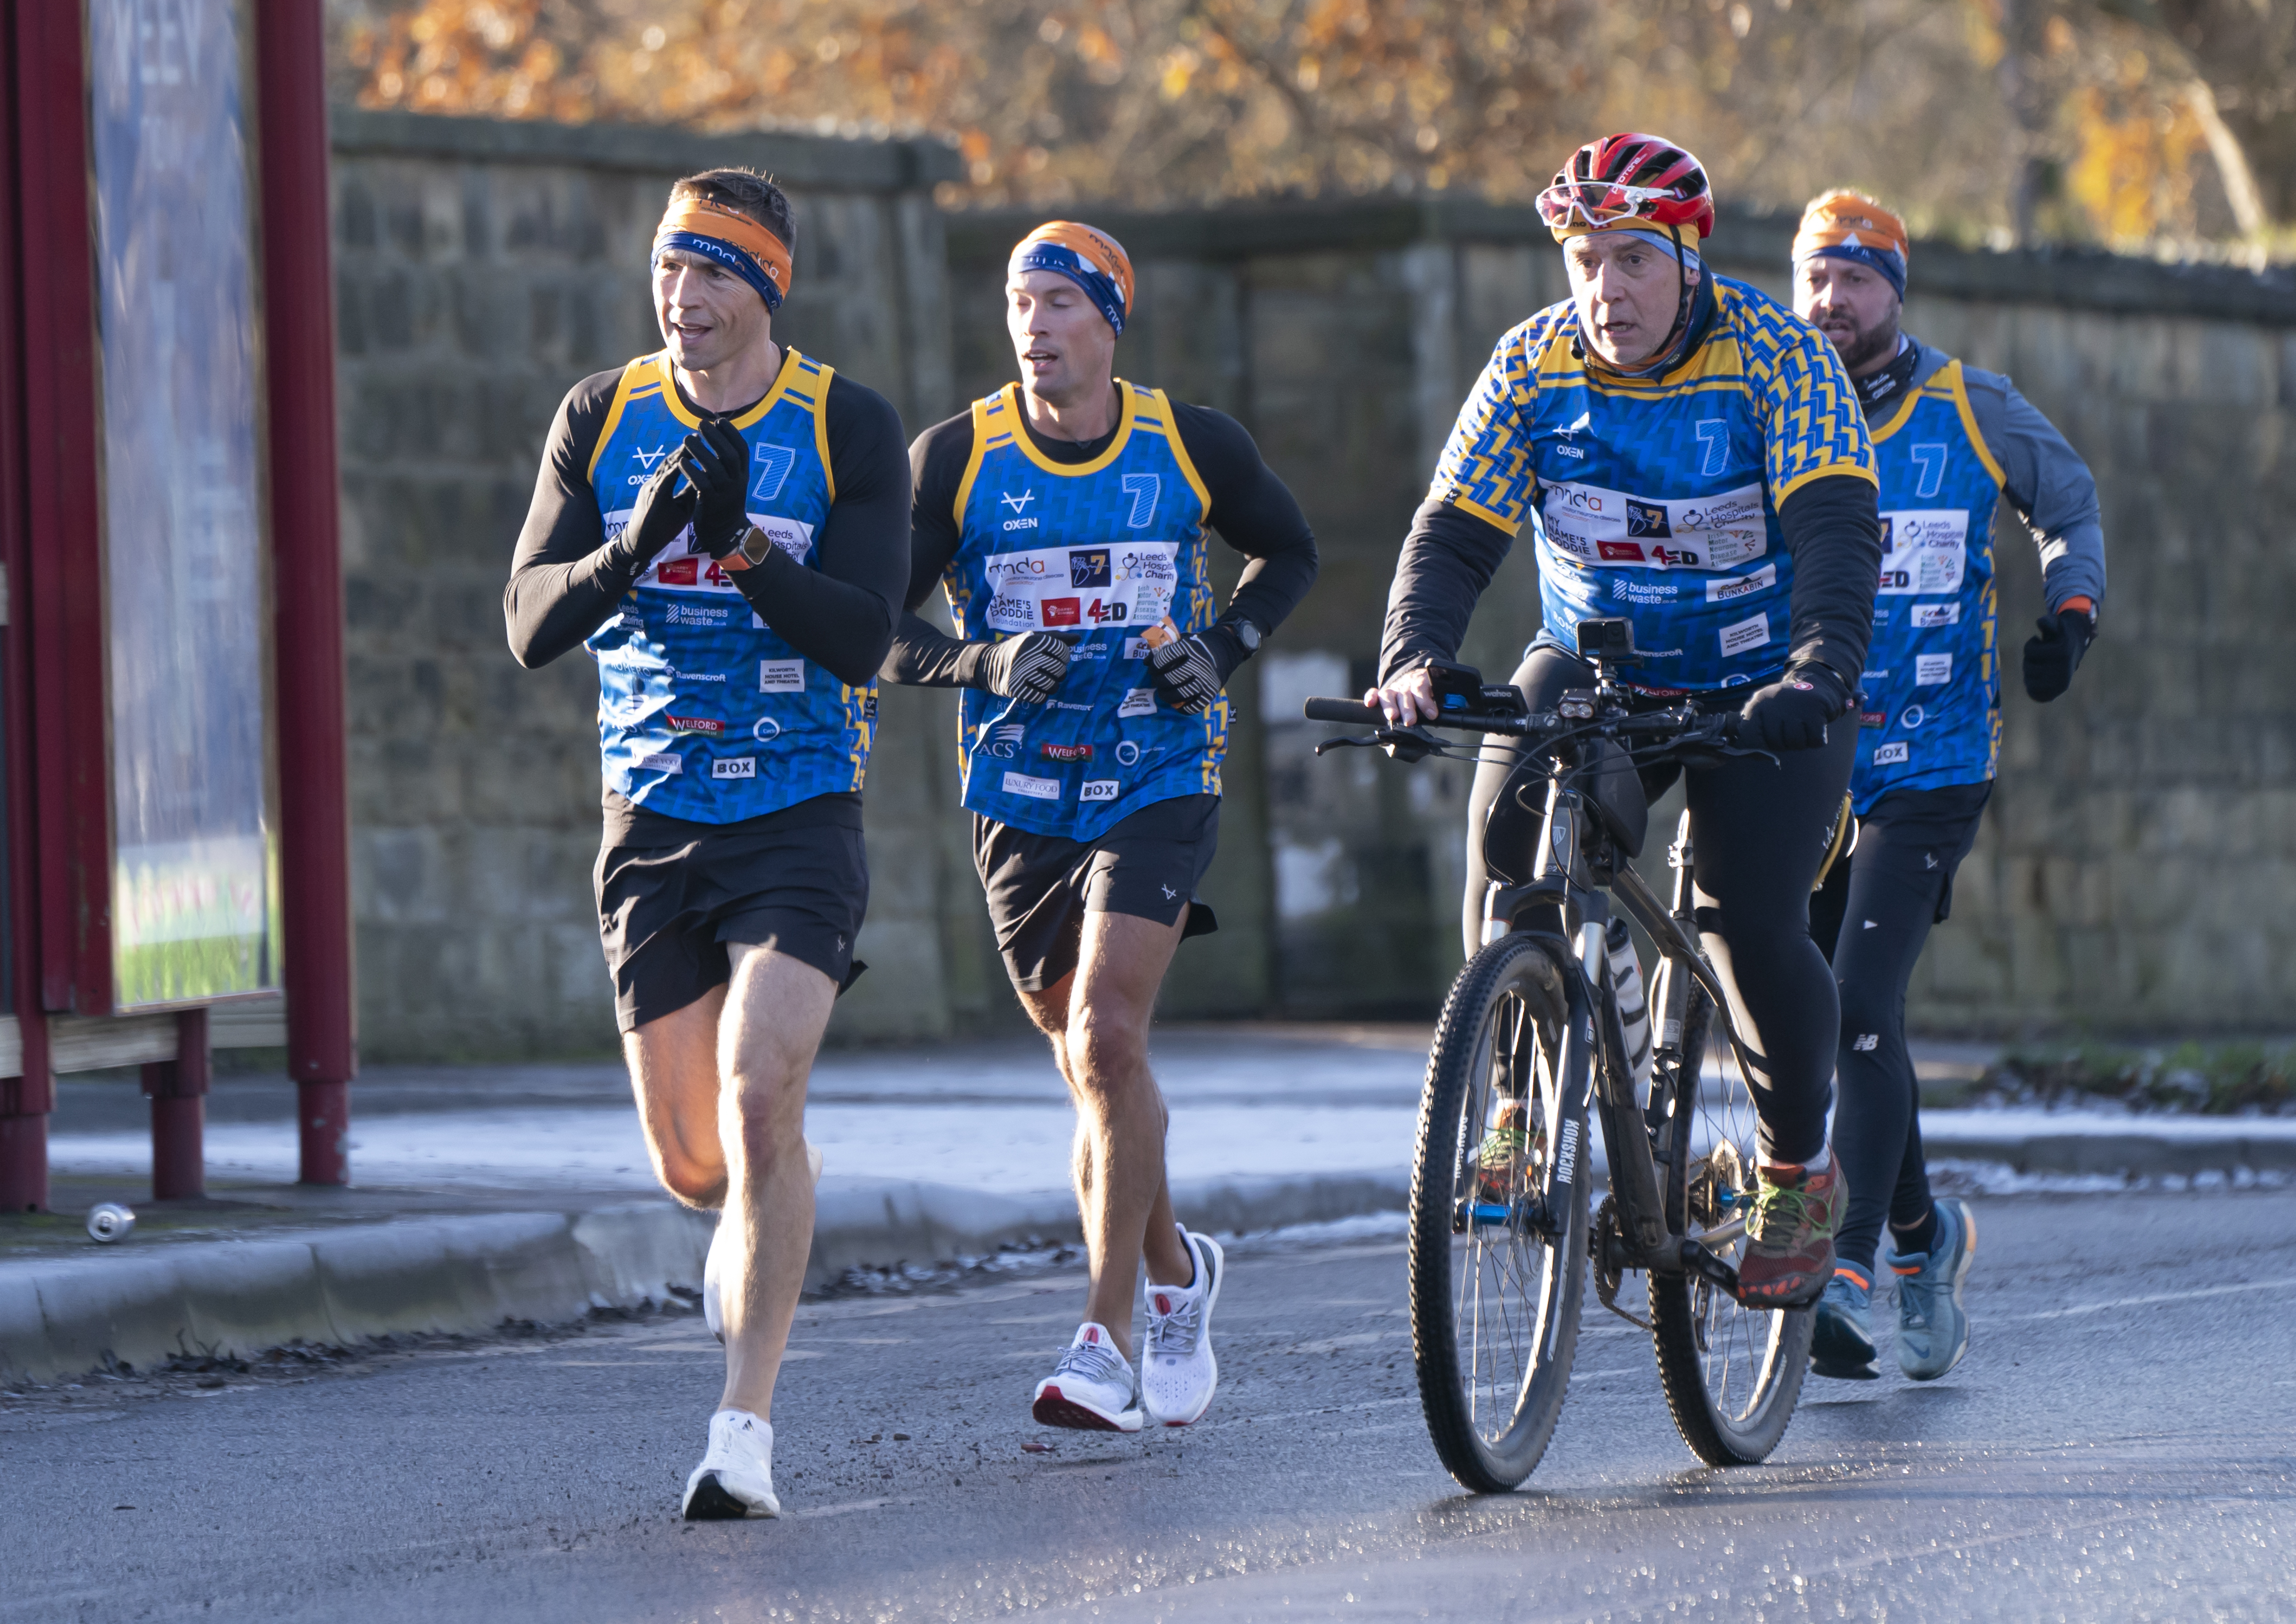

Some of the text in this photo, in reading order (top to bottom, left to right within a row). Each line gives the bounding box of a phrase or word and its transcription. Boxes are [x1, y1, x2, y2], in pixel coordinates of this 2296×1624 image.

[1557, 444, 1584, 459] OXEN
[1695, 418, 1730, 477] 7
[752, 442, 796, 501] 7
[1910, 443, 1948, 499] 7
[1121, 473, 1161, 529] 7
[1548, 485, 1602, 512] mnda
[1705, 500, 1738, 517] Leeds
[1711, 502, 1759, 523] Hospitals
[1003, 517, 1038, 531] OXEN
[1547, 513, 1560, 525] MY
[1646, 509, 1663, 529] 7
[1708, 531, 1724, 539] Irish
[1708, 537, 1728, 546] Motor
[1549, 532, 1591, 555] DODDIE
[1709, 542, 1738, 553] Neurone
[1140, 552, 1167, 561] Leeds
[1651, 545, 1699, 566] 4ED
[1710, 549, 1738, 561] Disease
[988, 557, 1045, 578] mnda
[1090, 555, 1106, 574] 7
[1145, 570, 1174, 582] Charity
[1628, 582, 1678, 594] business
[1717, 580, 1764, 599] BUNKABIN
[618, 603, 639, 614] Leeds
[681, 605, 728, 617] business
[991, 607, 1034, 620] DODDIE
[1087, 598, 1128, 624] 4ED
[1725, 628, 1763, 644] HOUSE HOTEL
[1729, 624, 1759, 638] KILWORTH
[1740, 632, 1764, 645] THEATRE
[1632, 648, 1683, 657] avenscroft
[675, 671, 726, 682] Ravenscroft
[1483, 689, 1512, 697] wahoo
[675, 719, 717, 731] WELFORD
[978, 743, 1014, 759] ACS
[717, 762, 750, 774] BOX
[1005, 778, 1058, 793] LUXURY FOOD
[1084, 785, 1114, 797] BOX
[1557, 1118, 1580, 1185] ROCKSHOX
